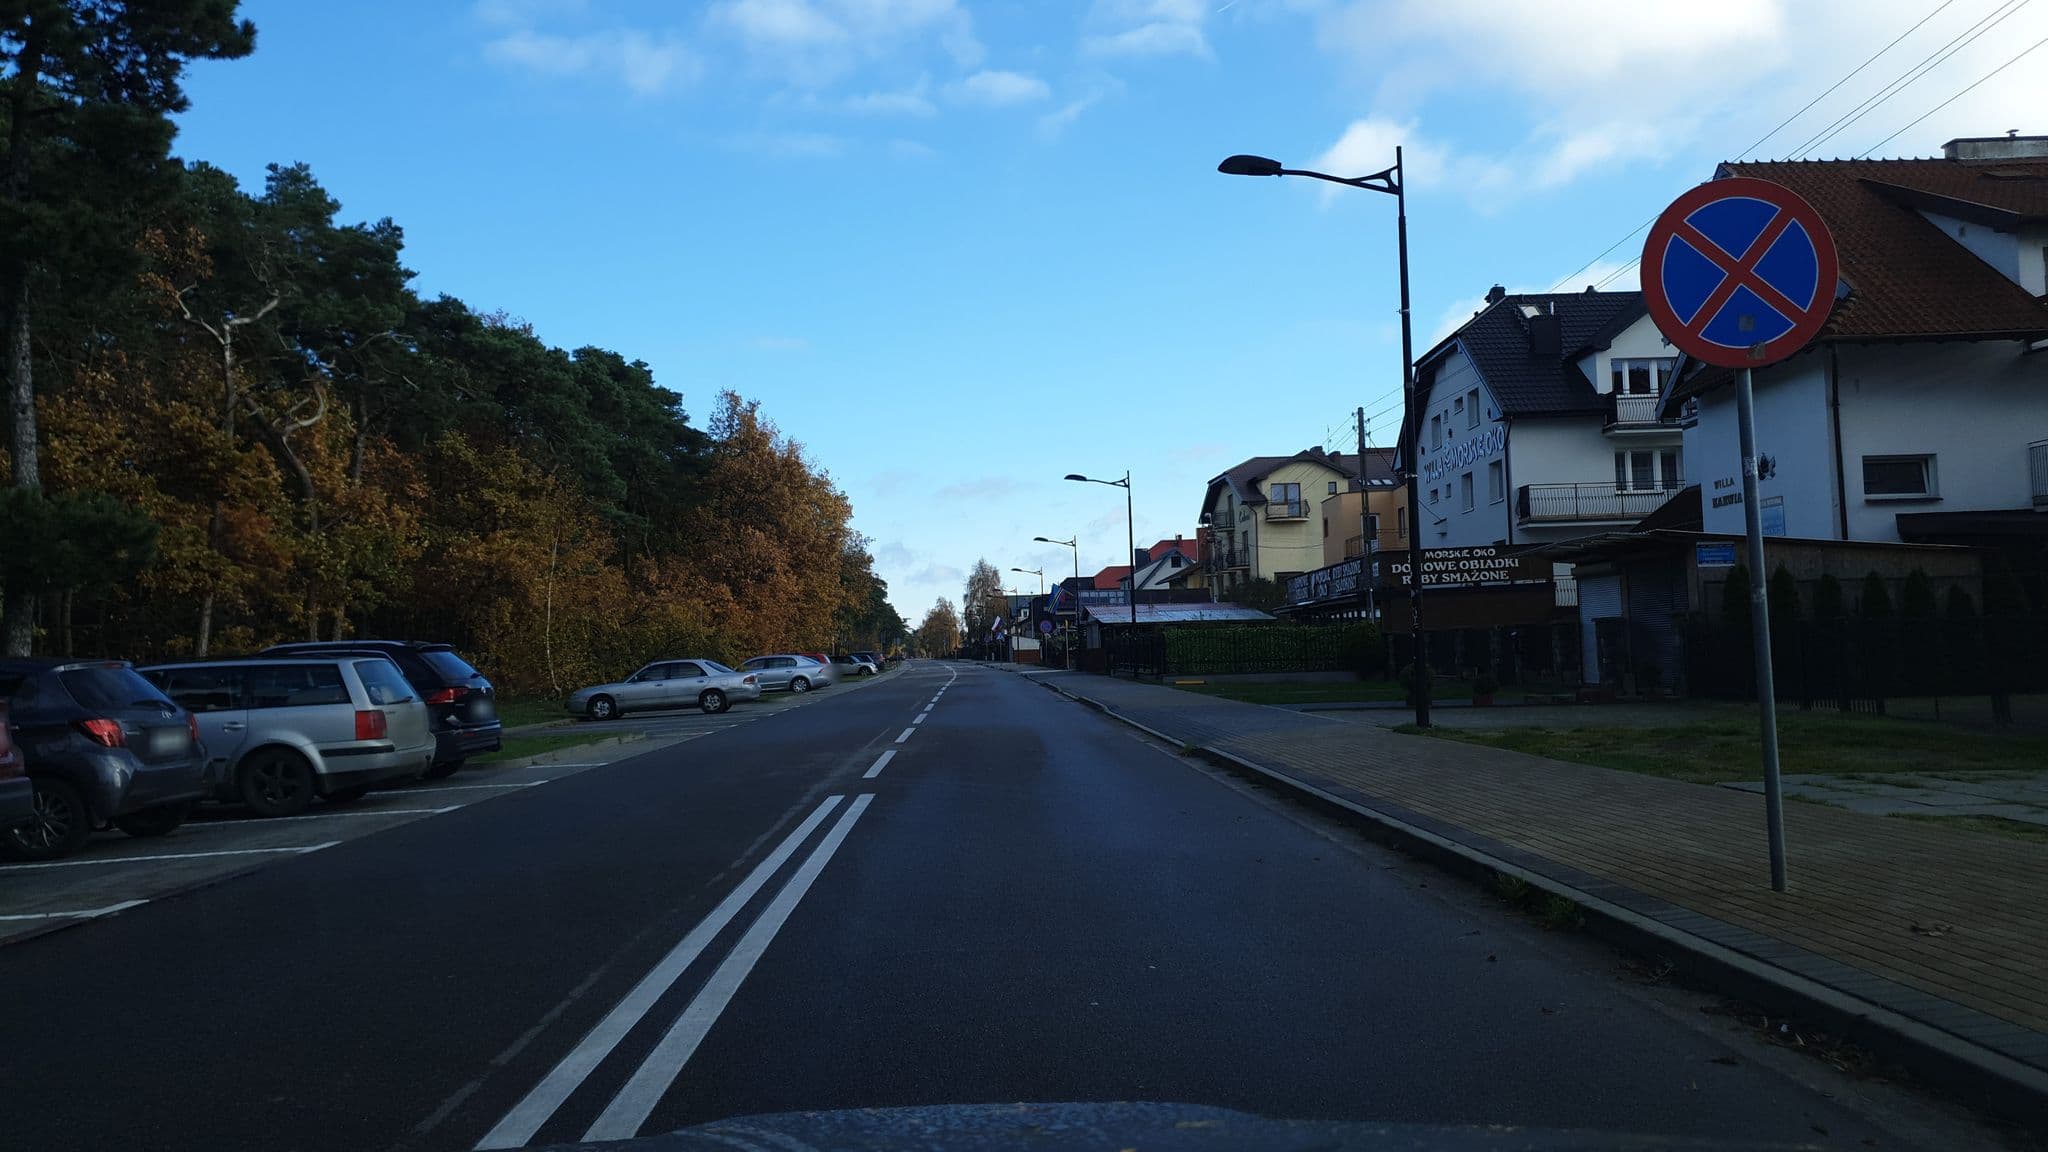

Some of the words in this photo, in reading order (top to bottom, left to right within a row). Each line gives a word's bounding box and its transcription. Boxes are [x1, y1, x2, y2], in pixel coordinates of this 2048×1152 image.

[1485, 425, 1505, 455] OKO
[1425, 550, 1470, 559] MORSKIE
[1473, 548, 1496, 557] OKO
[1392, 561, 1457, 573] DOOWE
[1460, 558, 1519, 570] OBIADKI
[1402, 574, 1439, 584] RBY
[1442, 569, 1509, 583] SMAŻONE
